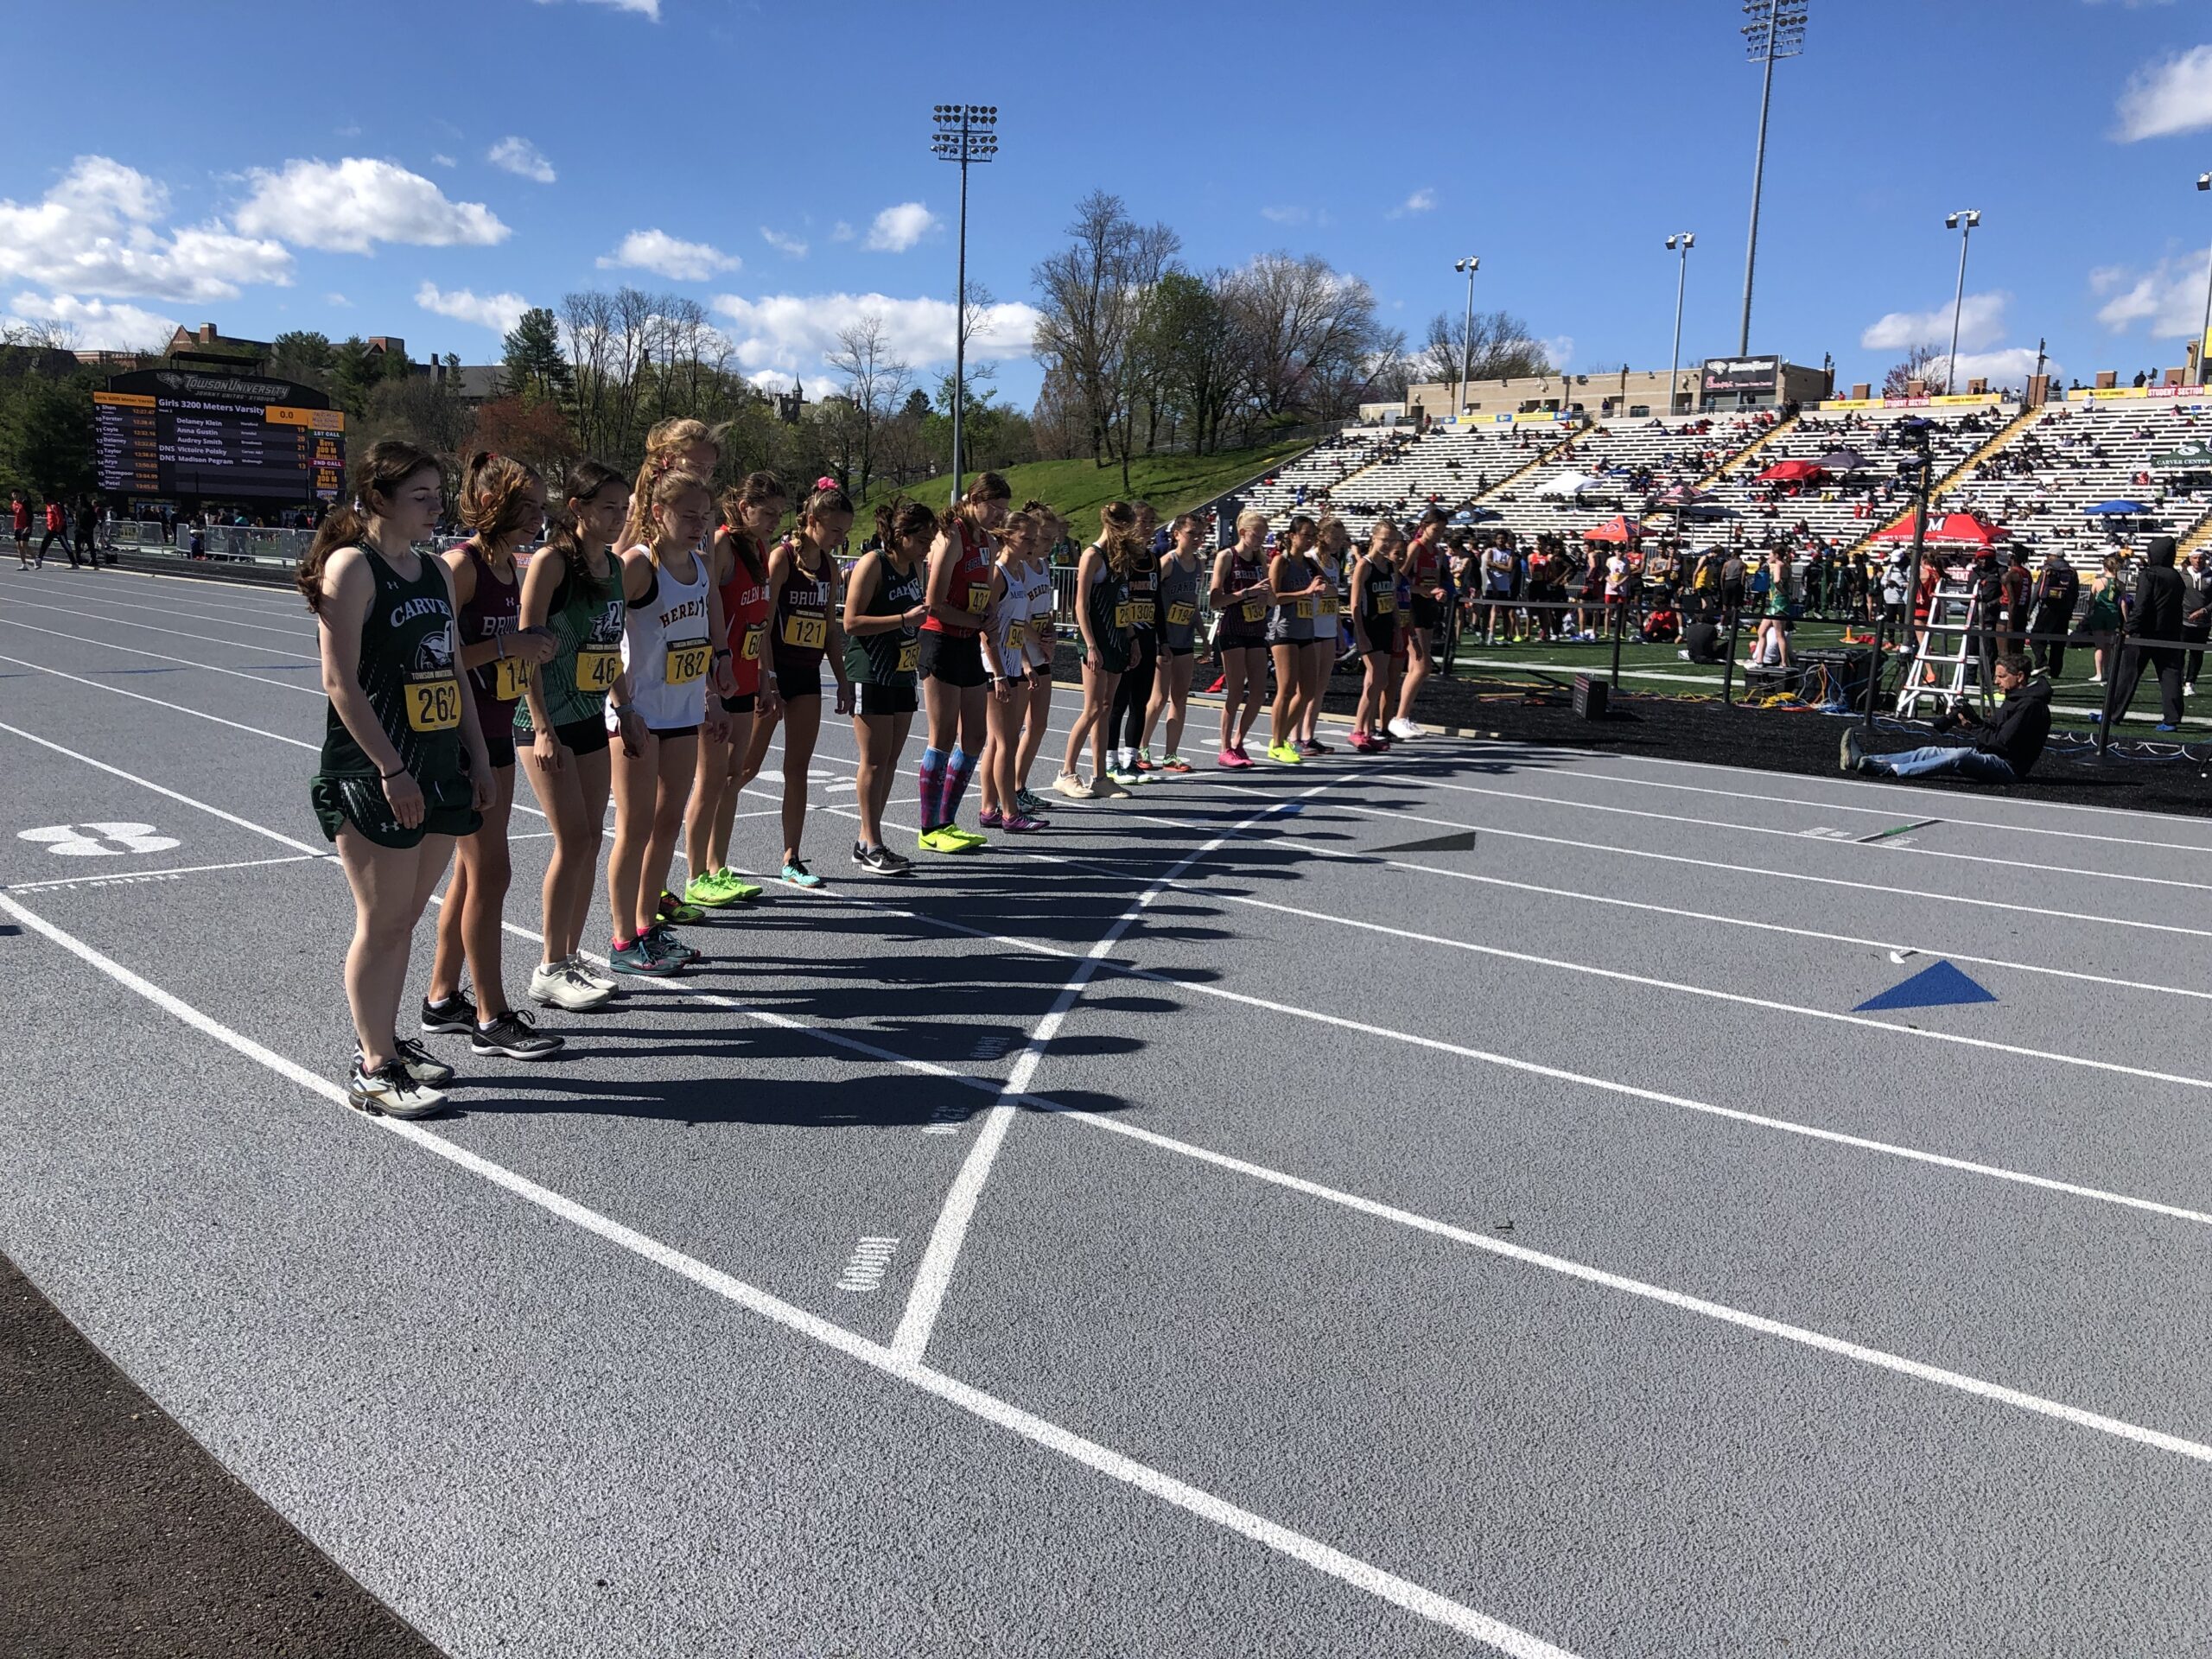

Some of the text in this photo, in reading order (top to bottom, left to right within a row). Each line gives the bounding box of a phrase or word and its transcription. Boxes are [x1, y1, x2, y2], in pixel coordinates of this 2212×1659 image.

[185, 374, 289, 398] TOWSON UNIVERSITY
[2177, 386, 2203, 395] SECTION
[158, 398, 264, 416] Girls 3200 Meters Varsity
[280, 410, 294, 419] 0.0
[176, 417, 204, 426] Delaney
[177, 436, 202, 445] Audrey
[205, 448, 227, 456] Polsky
[1926, 518, 1946, 532] M
[741, 585, 760, 606] GLEN
[796, 620, 822, 644] 121
[592, 658, 616, 685] 46
[675, 651, 704, 680] 782
[418, 685, 457, 724] 262
[17, 822, 181, 855] 8
